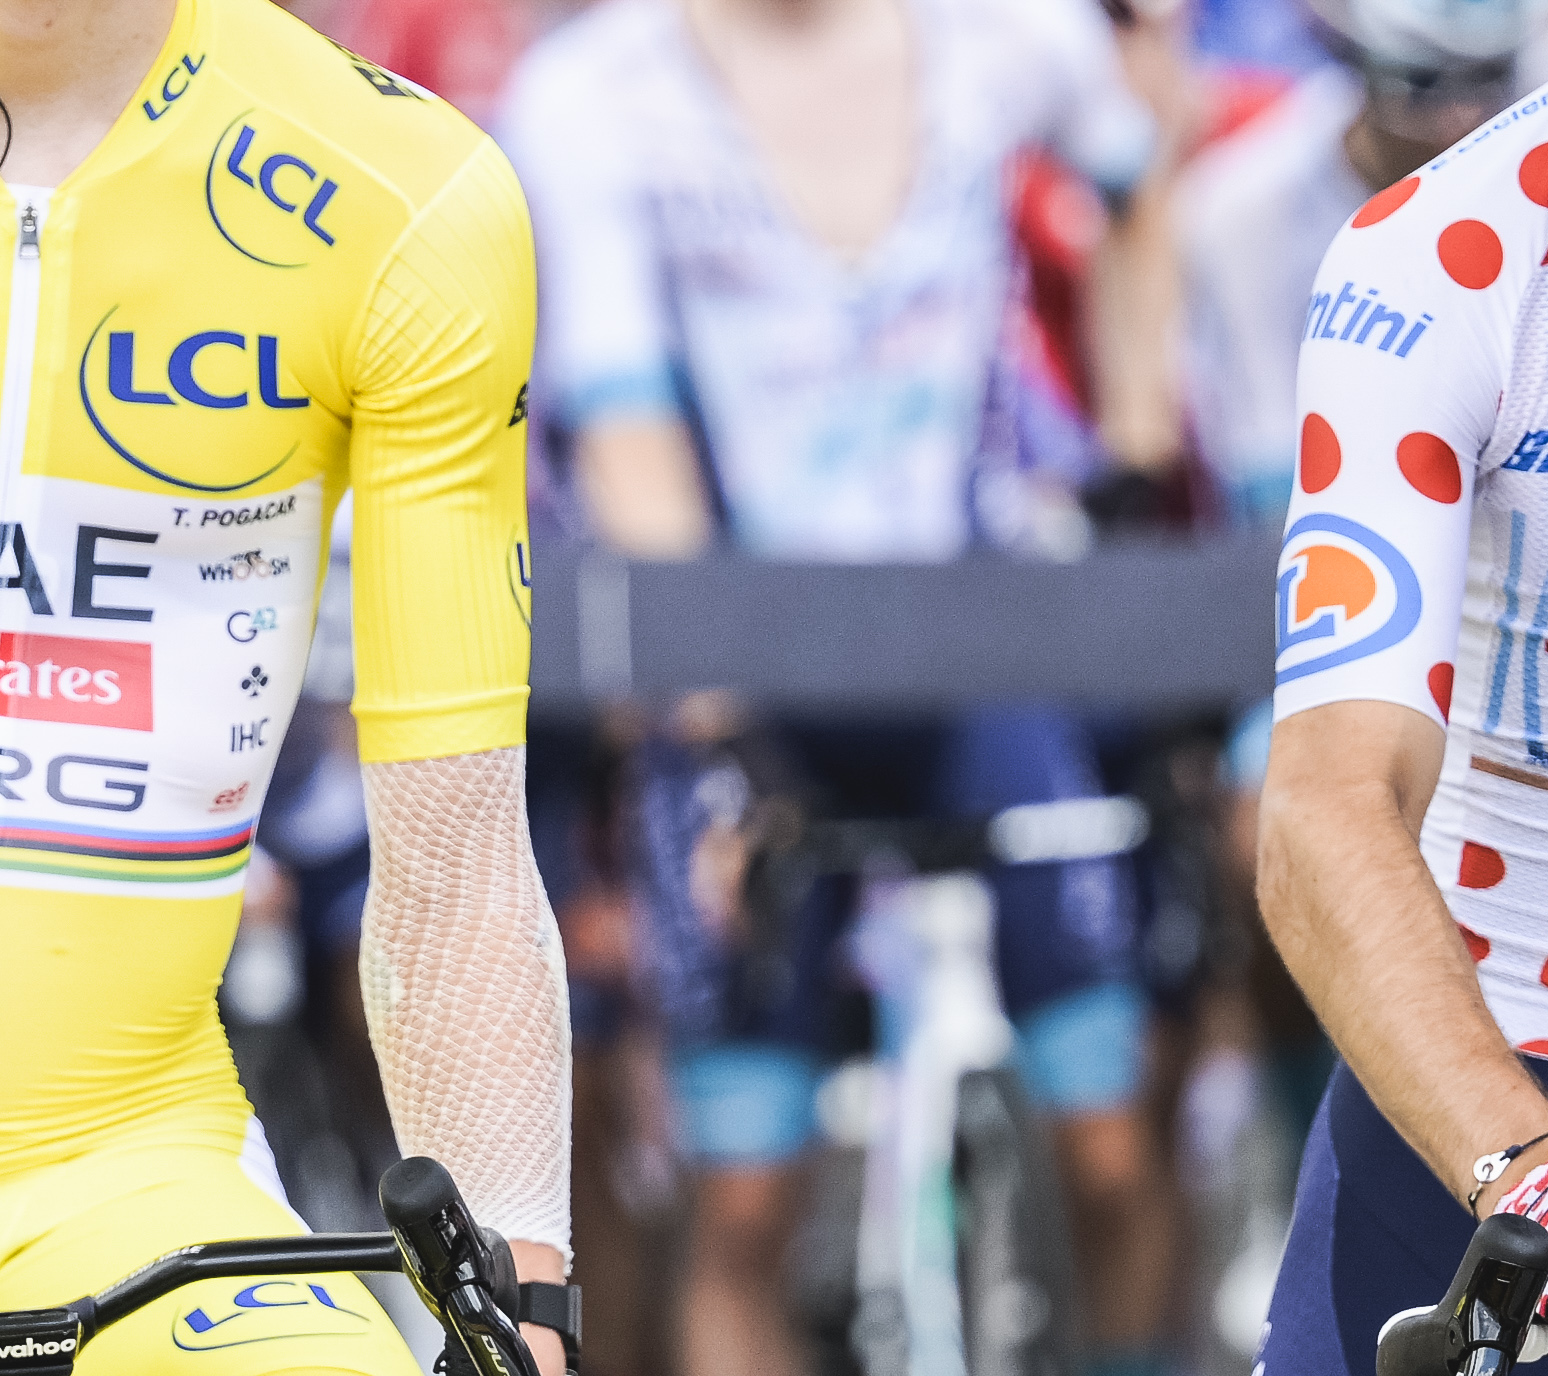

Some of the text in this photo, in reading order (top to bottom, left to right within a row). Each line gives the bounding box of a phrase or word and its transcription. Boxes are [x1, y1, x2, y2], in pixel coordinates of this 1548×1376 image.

[142, 53, 206, 122] LCL
[226, 125, 339, 247] LCL
[1303, 281, 1435, 358] ntini
[107, 330, 312, 410] LCL
